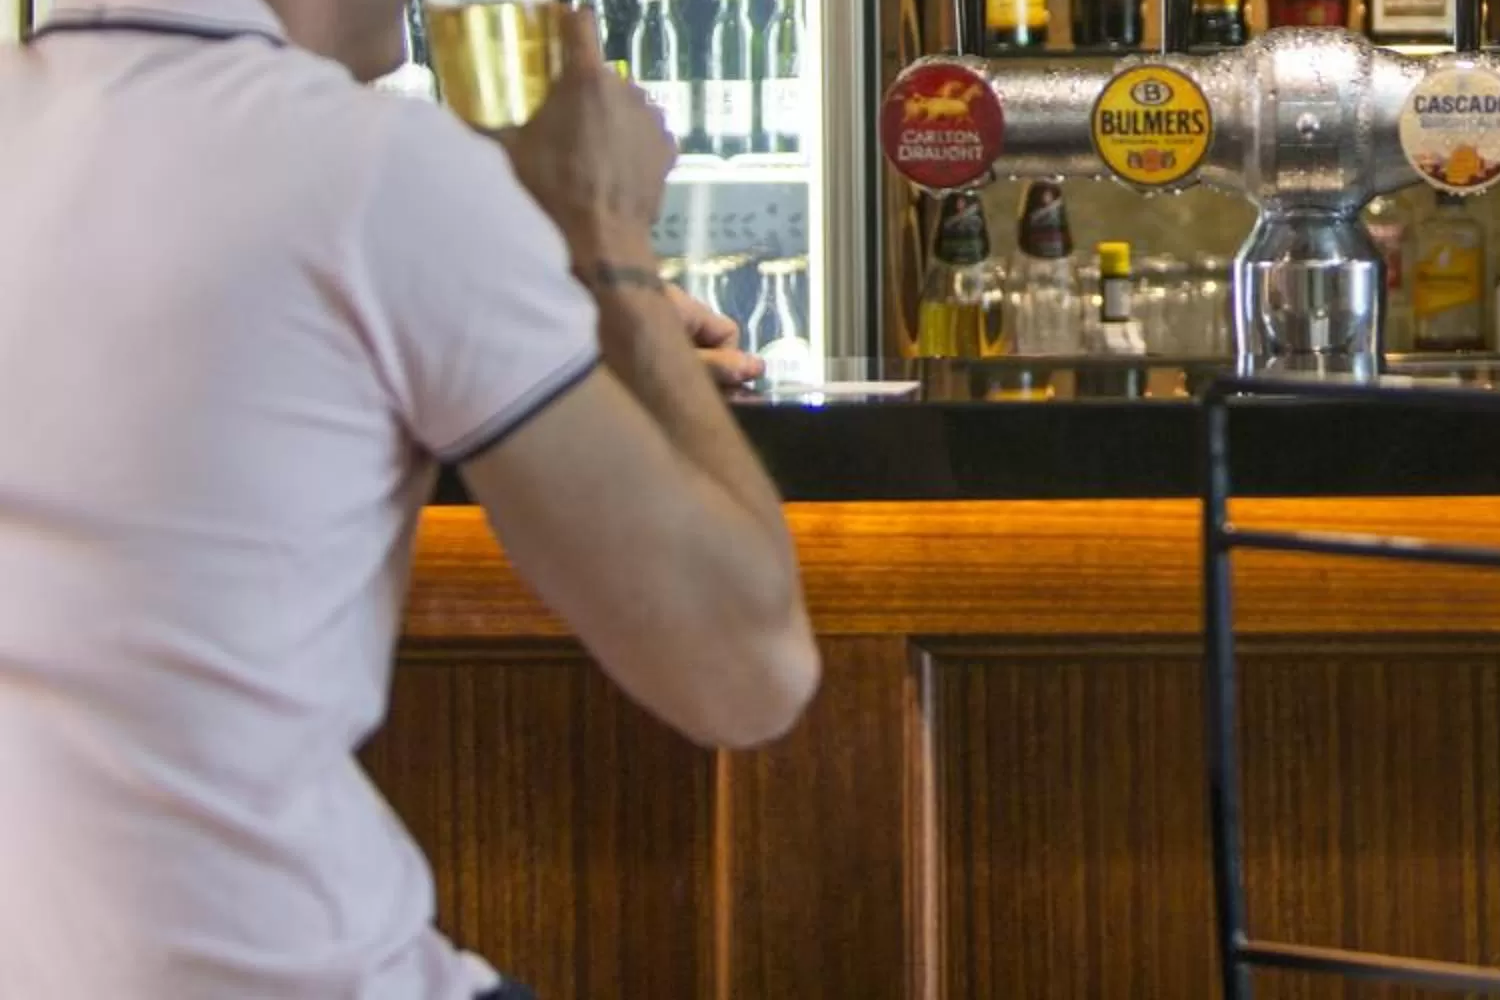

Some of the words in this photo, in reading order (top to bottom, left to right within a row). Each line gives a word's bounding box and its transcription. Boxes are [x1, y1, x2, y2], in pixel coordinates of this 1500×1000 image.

[1145, 84, 1161, 101] B
[1101, 110, 1205, 135] BULMERS
[899, 128, 982, 144] CARLTON
[898, 144, 984, 161] DRAUGHT
